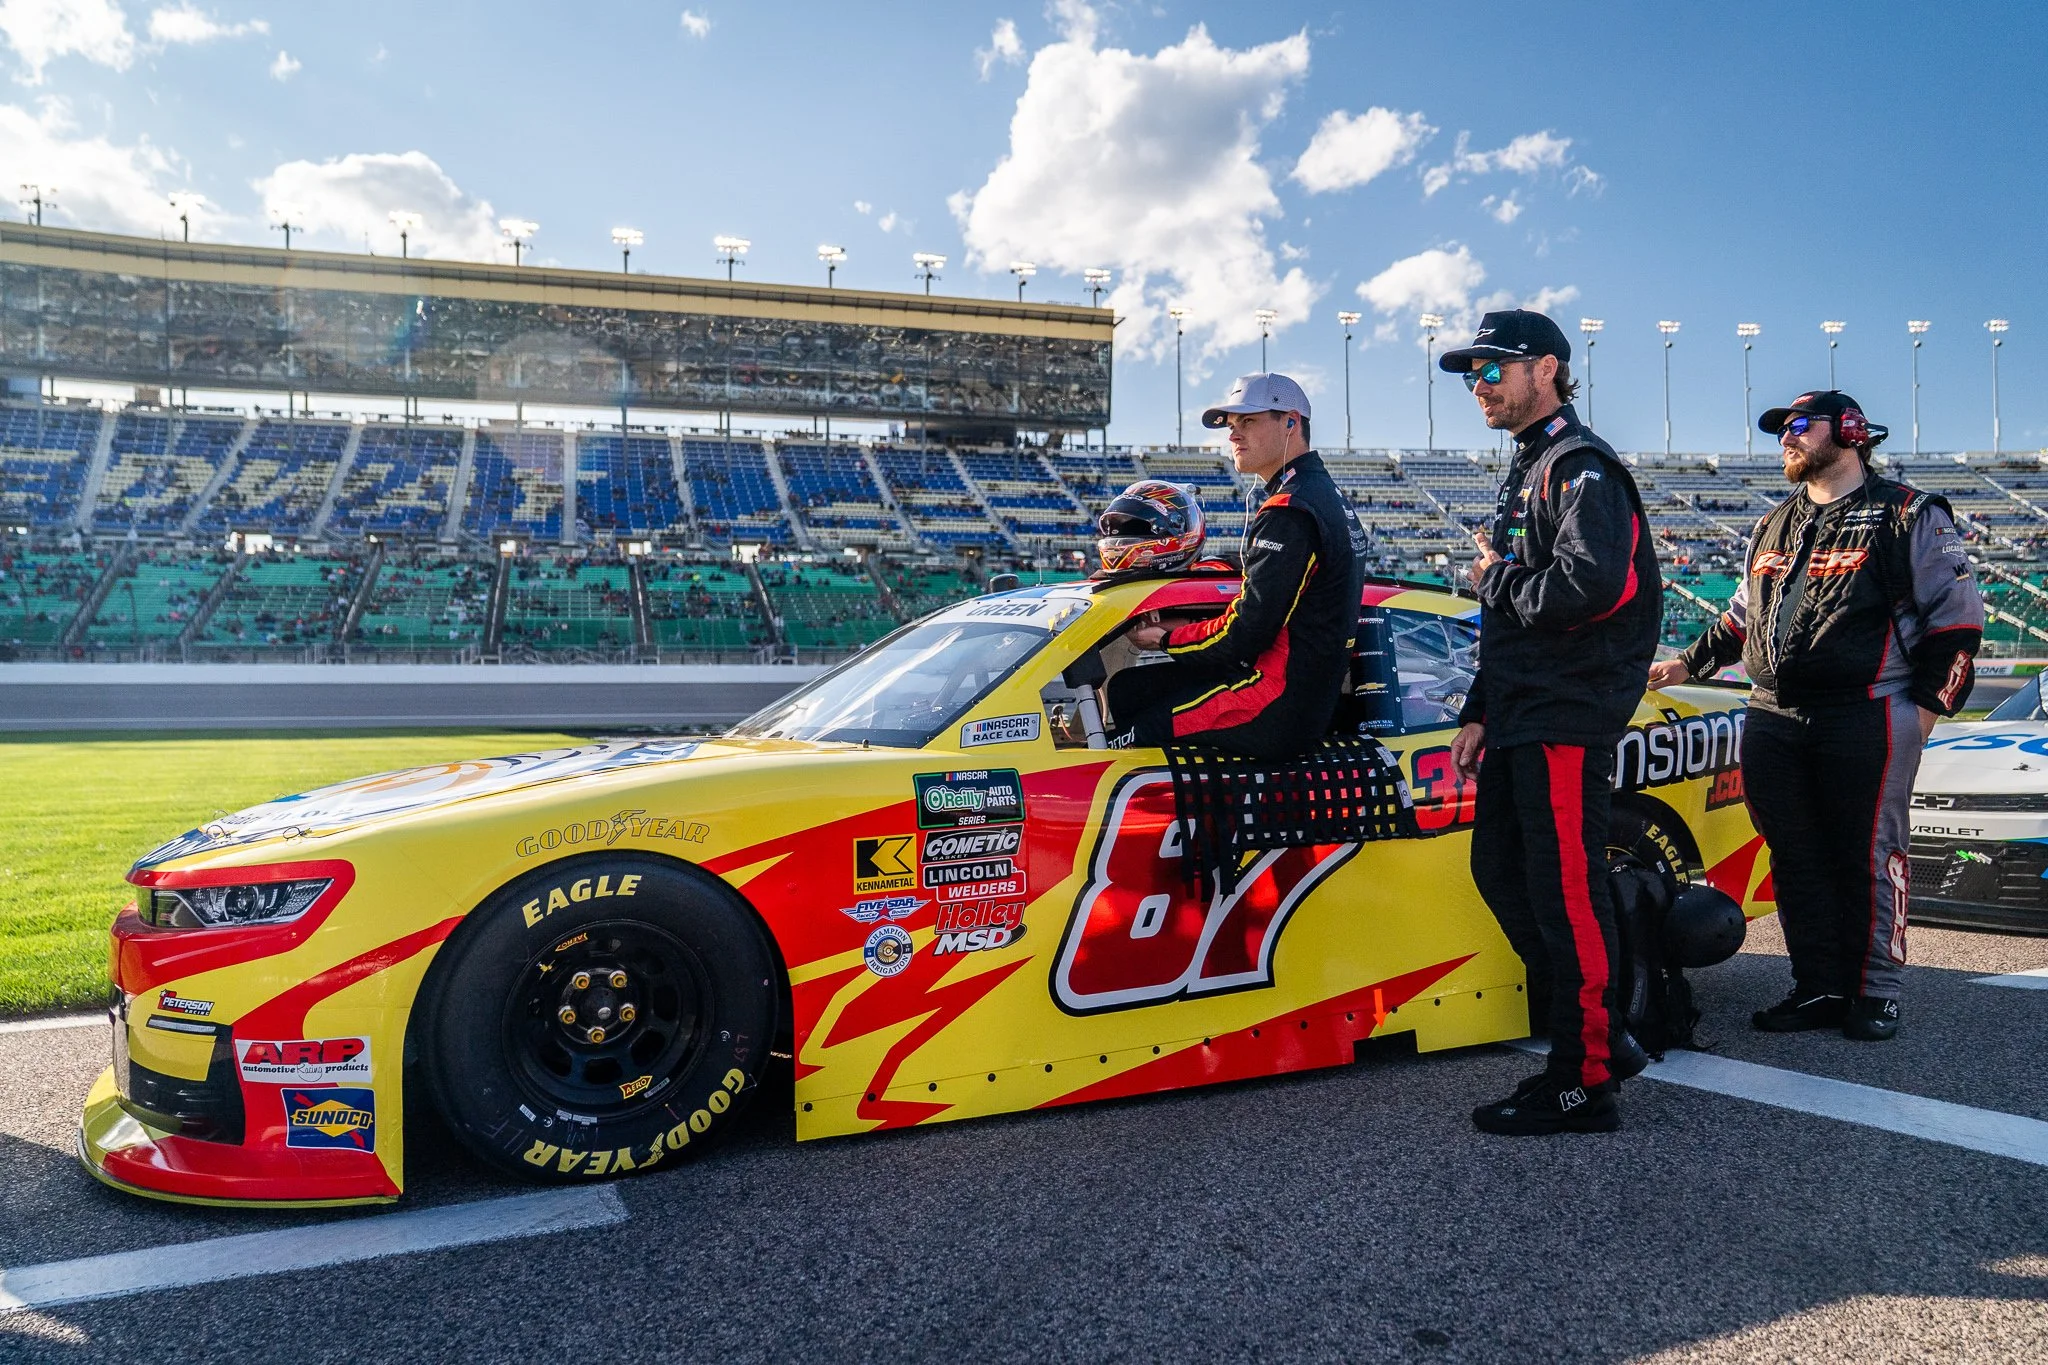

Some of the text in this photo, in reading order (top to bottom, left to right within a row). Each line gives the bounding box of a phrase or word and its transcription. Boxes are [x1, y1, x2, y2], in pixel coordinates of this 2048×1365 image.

[966, 603, 1048, 617] GREEN
[986, 717, 1030, 732] NASCAR
[973, 728, 1029, 743] RACE CAR
[956, 771, 988, 781] NASCAR
[988, 786, 1013, 796] AUTO
[926, 788, 984, 811] O'Reilly
[986, 794, 1016, 807] PARTS
[958, 816, 986, 826] SERIES
[926, 829, 1019, 858] COMETIC
[932, 854, 968, 862] GASKET
[1646, 824, 1690, 886] EAGLE
[929, 864, 1009, 884] LINCOLN
[856, 878, 914, 892] KENNAMETAL
[948, 880, 1017, 899] WELDERS
[522, 874, 642, 928] EAGLE
[857, 898, 914, 914] FIVE STAR
[936, 902, 1025, 931] Holley
[870, 928, 908, 944] CHAMPION
[934, 929, 1012, 956] MSD
[869, 955, 908, 974] IRRIGATION
[162, 996, 215, 1012] PETERSON
[242, 1038, 365, 1064] ARP
[242, 1064, 296, 1074] automotive
[324, 1063, 369, 1074] products
[625, 1078, 647, 1094] AERO
[1560, 1087, 1587, 1112] K1
[294, 1110, 372, 1128] SUNOCO
[524, 1068, 745, 1175] GOODYEAR
